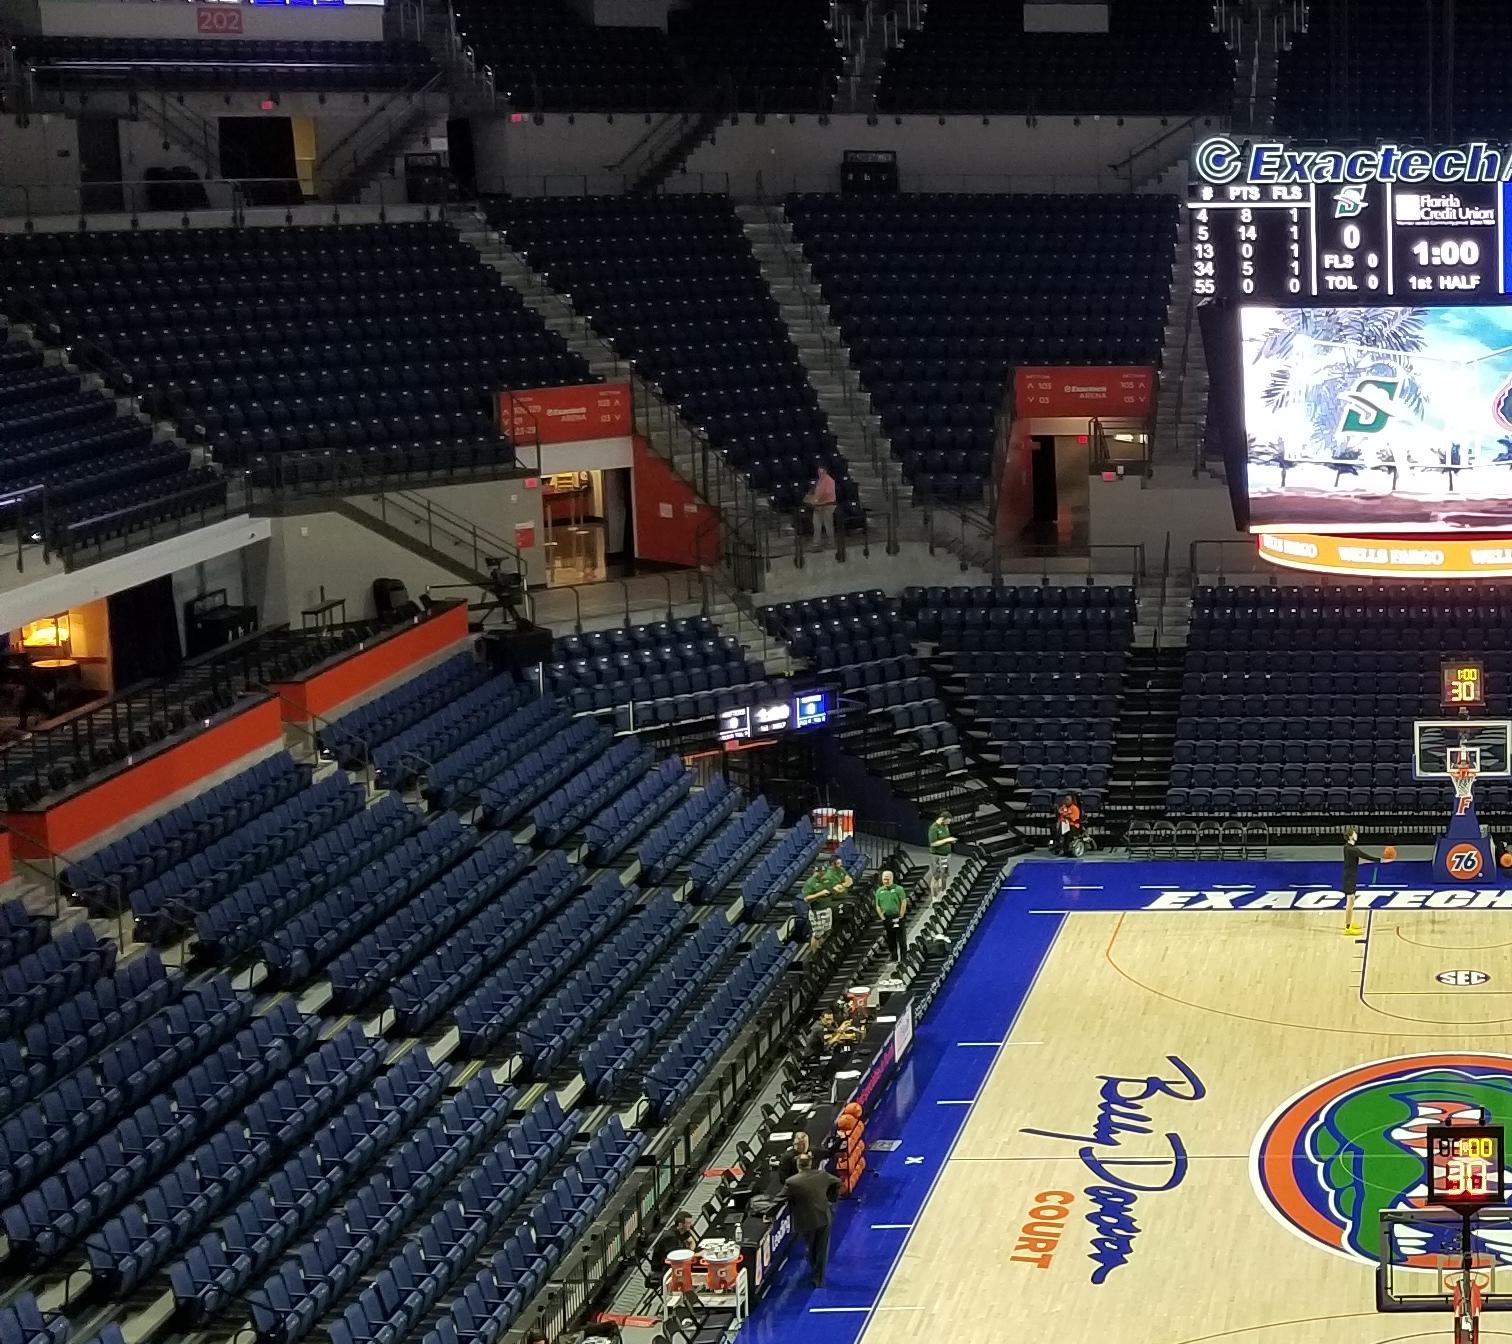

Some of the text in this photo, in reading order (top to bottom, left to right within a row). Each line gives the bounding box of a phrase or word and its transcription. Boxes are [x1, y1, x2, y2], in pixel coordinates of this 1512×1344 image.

[199, 11, 241, 31] 202
[1247, 142, 1501, 184] Exactech
[1229, 186, 1261, 201] PTS
[1272, 185, 1303, 200] FLS
[1420, 194, 1461, 208] Florida
[1196, 207, 1298, 223] 4 8 1
[1420, 207, 1495, 220] Credit Union
[1197, 225, 1298, 241] 5 14 1
[1343, 224, 1361, 249] 0
[1194, 243, 1299, 259] 13 0 1
[1412, 240, 1480, 266] 1:00
[1193, 260, 1299, 276] 34 5 1
[1323, 253, 1378, 269] FLS 0
[1194, 278, 1300, 294] 55 0 0
[1325, 274, 1379, 290] TOL 0
[1408, 275, 1481, 290] 1st HALF
[1038, 396, 1050, 404] 03
[1457, 668, 1477, 681] 1:00
[1451, 680, 1475, 702] 30
[1455, 795, 1473, 816] F
[1451, 850, 1478, 872] 76
[1439, 970, 1486, 985] SEC
[1446, 1160, 1487, 1195] 30
[1010, 1190, 1076, 1269] COURT
